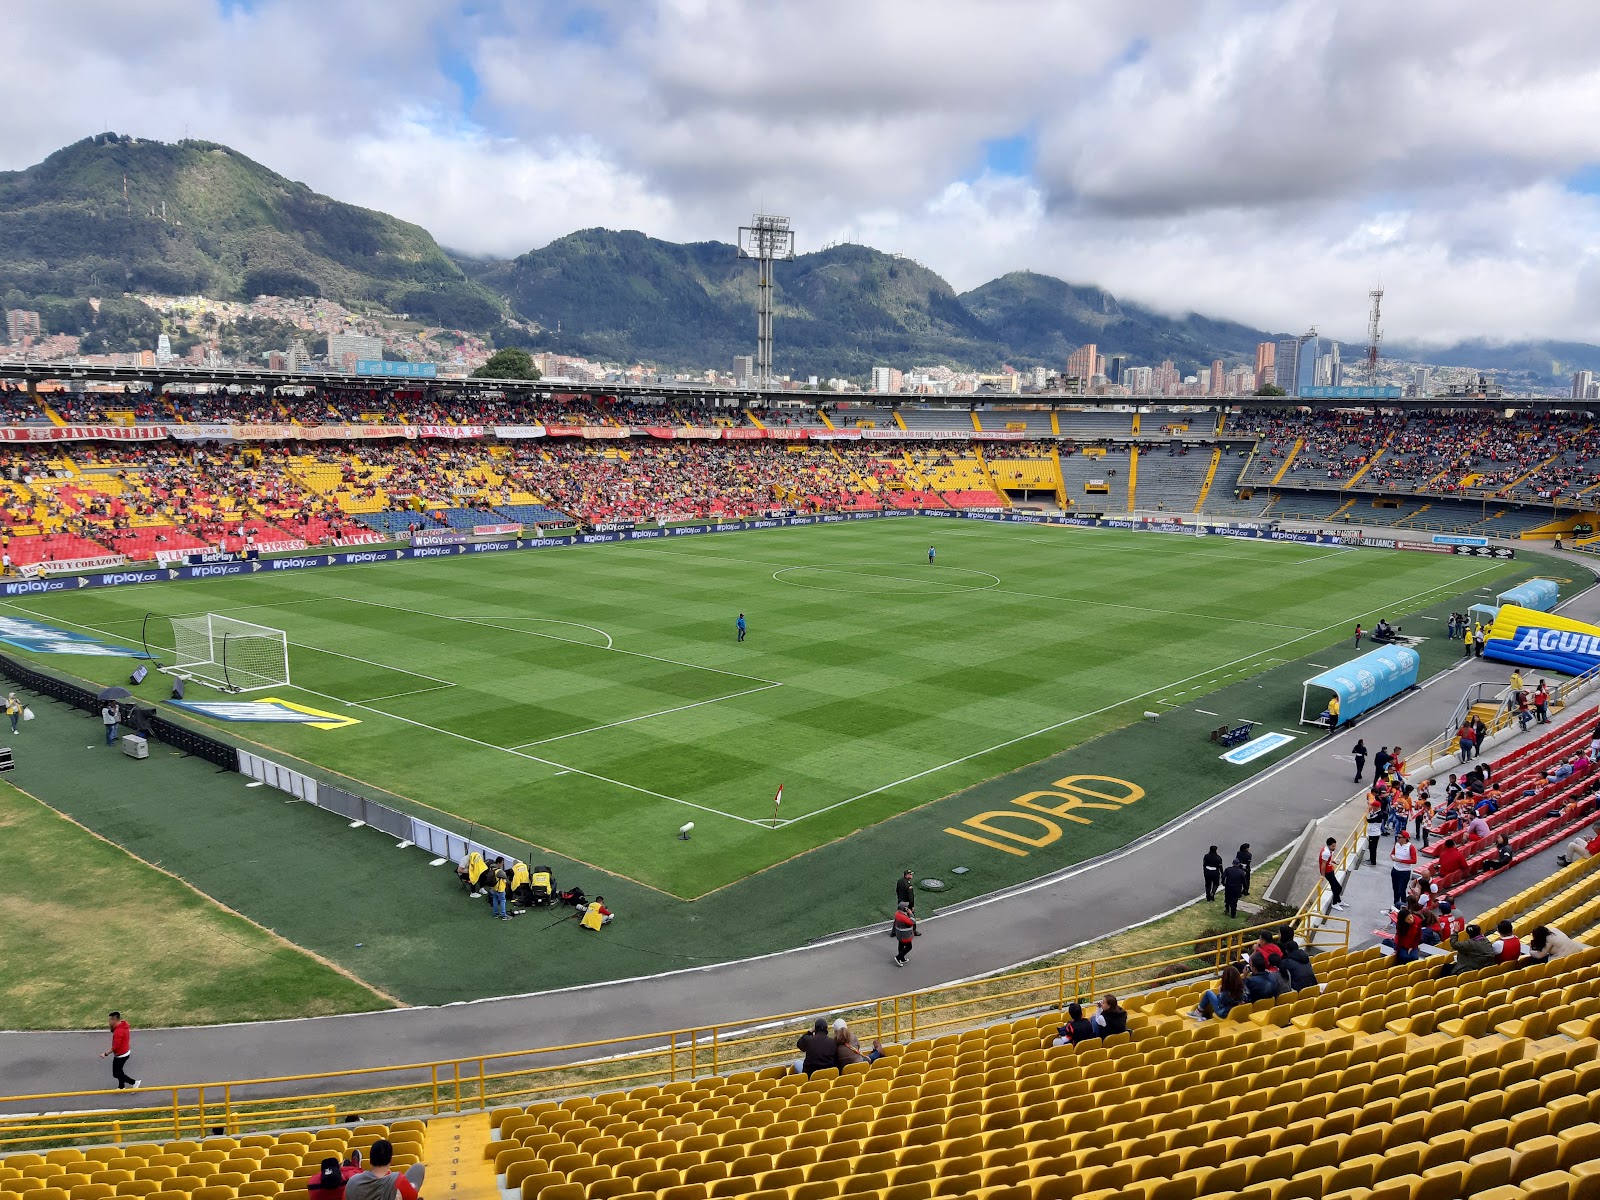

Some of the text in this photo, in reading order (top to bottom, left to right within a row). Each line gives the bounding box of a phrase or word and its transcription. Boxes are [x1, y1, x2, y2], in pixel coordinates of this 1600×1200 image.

[421, 426, 482, 436] BARRA 25
[1214, 527, 1248, 537] Wplay.co
[1271, 532, 1307, 541] Wplay.co
[415, 535, 453, 547] Wplay.co
[531, 537, 564, 547] Wplay.co
[413, 546, 451, 557] Wplay.co
[474, 542, 510, 552] Wplay.co
[169, 551, 182, 561] LA
[202, 552, 234, 562] BetPlay
[346, 552, 387, 563] Wplay.co
[24, 562, 64, 574] AGANTE
[273, 557, 318, 569] Wplay.co
[192, 565, 241, 577] Wplay.co
[103, 572, 157, 585] Wplay.co
[6, 582, 64, 594] Wplay.co
[943, 775, 1145, 857] IDRD
